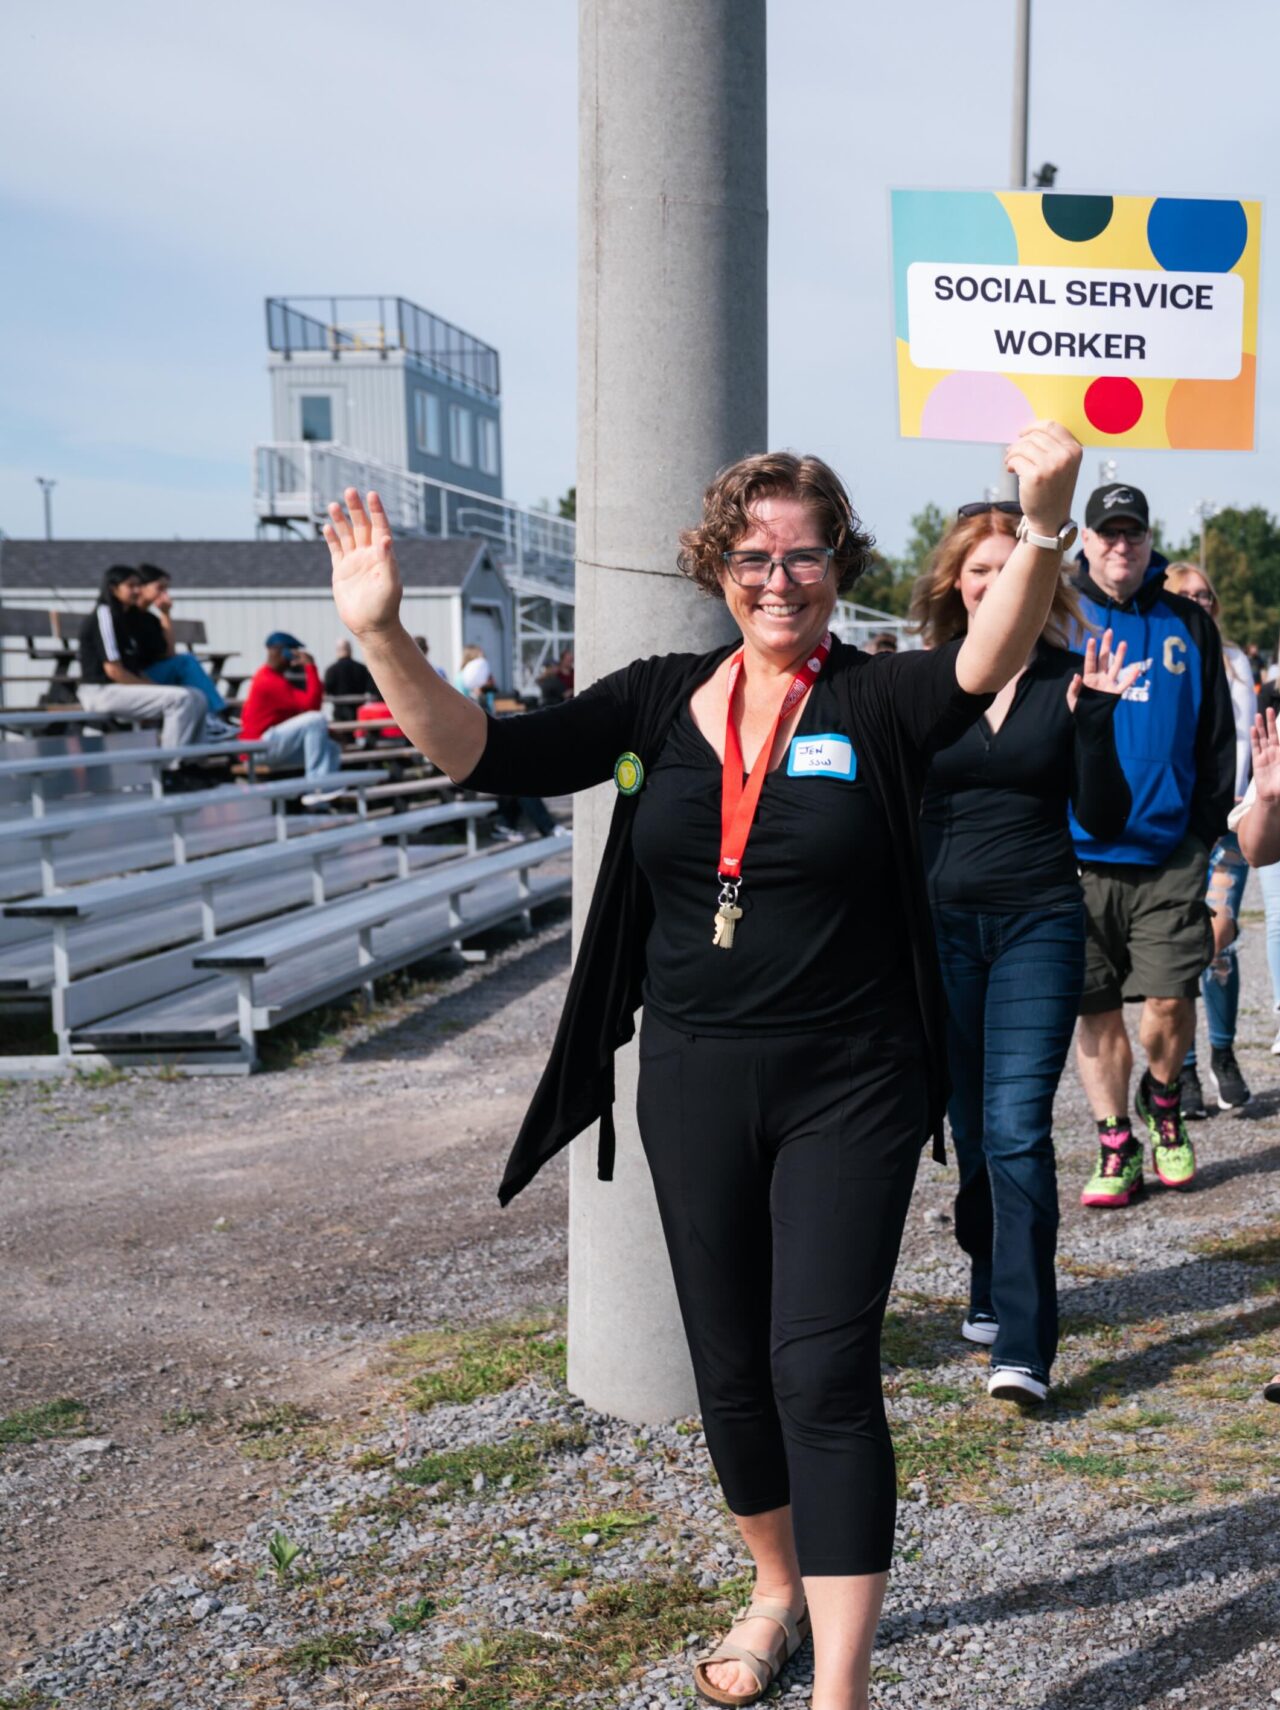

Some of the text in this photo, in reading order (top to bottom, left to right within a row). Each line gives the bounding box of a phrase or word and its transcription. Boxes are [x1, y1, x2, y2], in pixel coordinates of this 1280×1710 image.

[934, 275, 1214, 310] SOCIAL SERVICE
[994, 329, 1146, 359] WORKER
[1163, 635, 1186, 675] C
[799, 744, 823, 755] JEN
